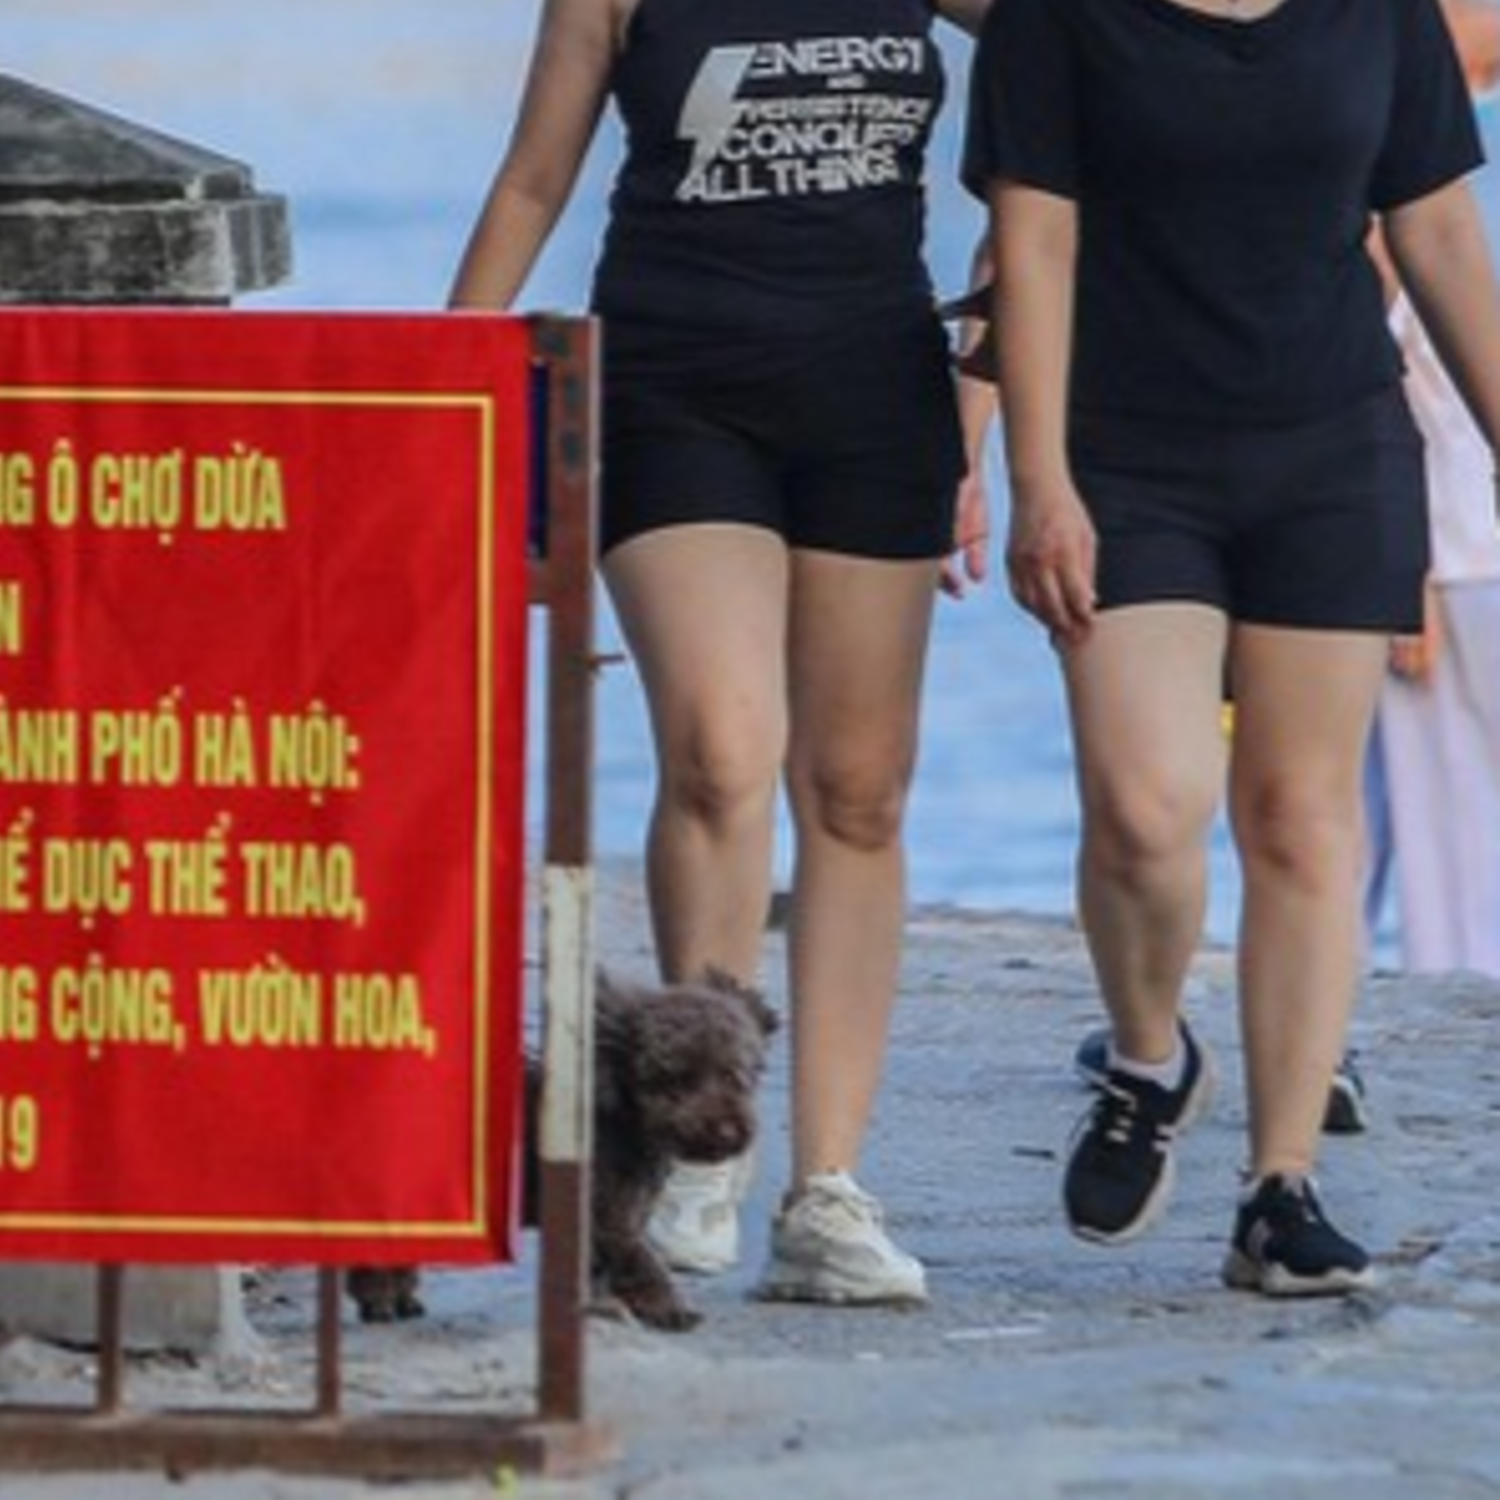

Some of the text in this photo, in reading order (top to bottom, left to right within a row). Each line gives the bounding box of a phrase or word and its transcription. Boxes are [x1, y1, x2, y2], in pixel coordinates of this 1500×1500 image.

[47, 437, 80, 528] Ô
[90, 448, 184, 546] CHỢ
[194, 441, 286, 531] DỪA
[90, 686, 183, 788] PHỐ
[194, 698, 257, 788] HÀ
[268, 700, 361, 805] NỘI:
[42, 837, 133, 929] DỤC
[144, 812, 232, 917] THỂ
[239, 841, 367, 926] THAO,
[50, 953, 187, 1058] CỘNG,
[198, 953, 322, 1047] VƯỜN
[333, 972, 438, 1057] HOA,
